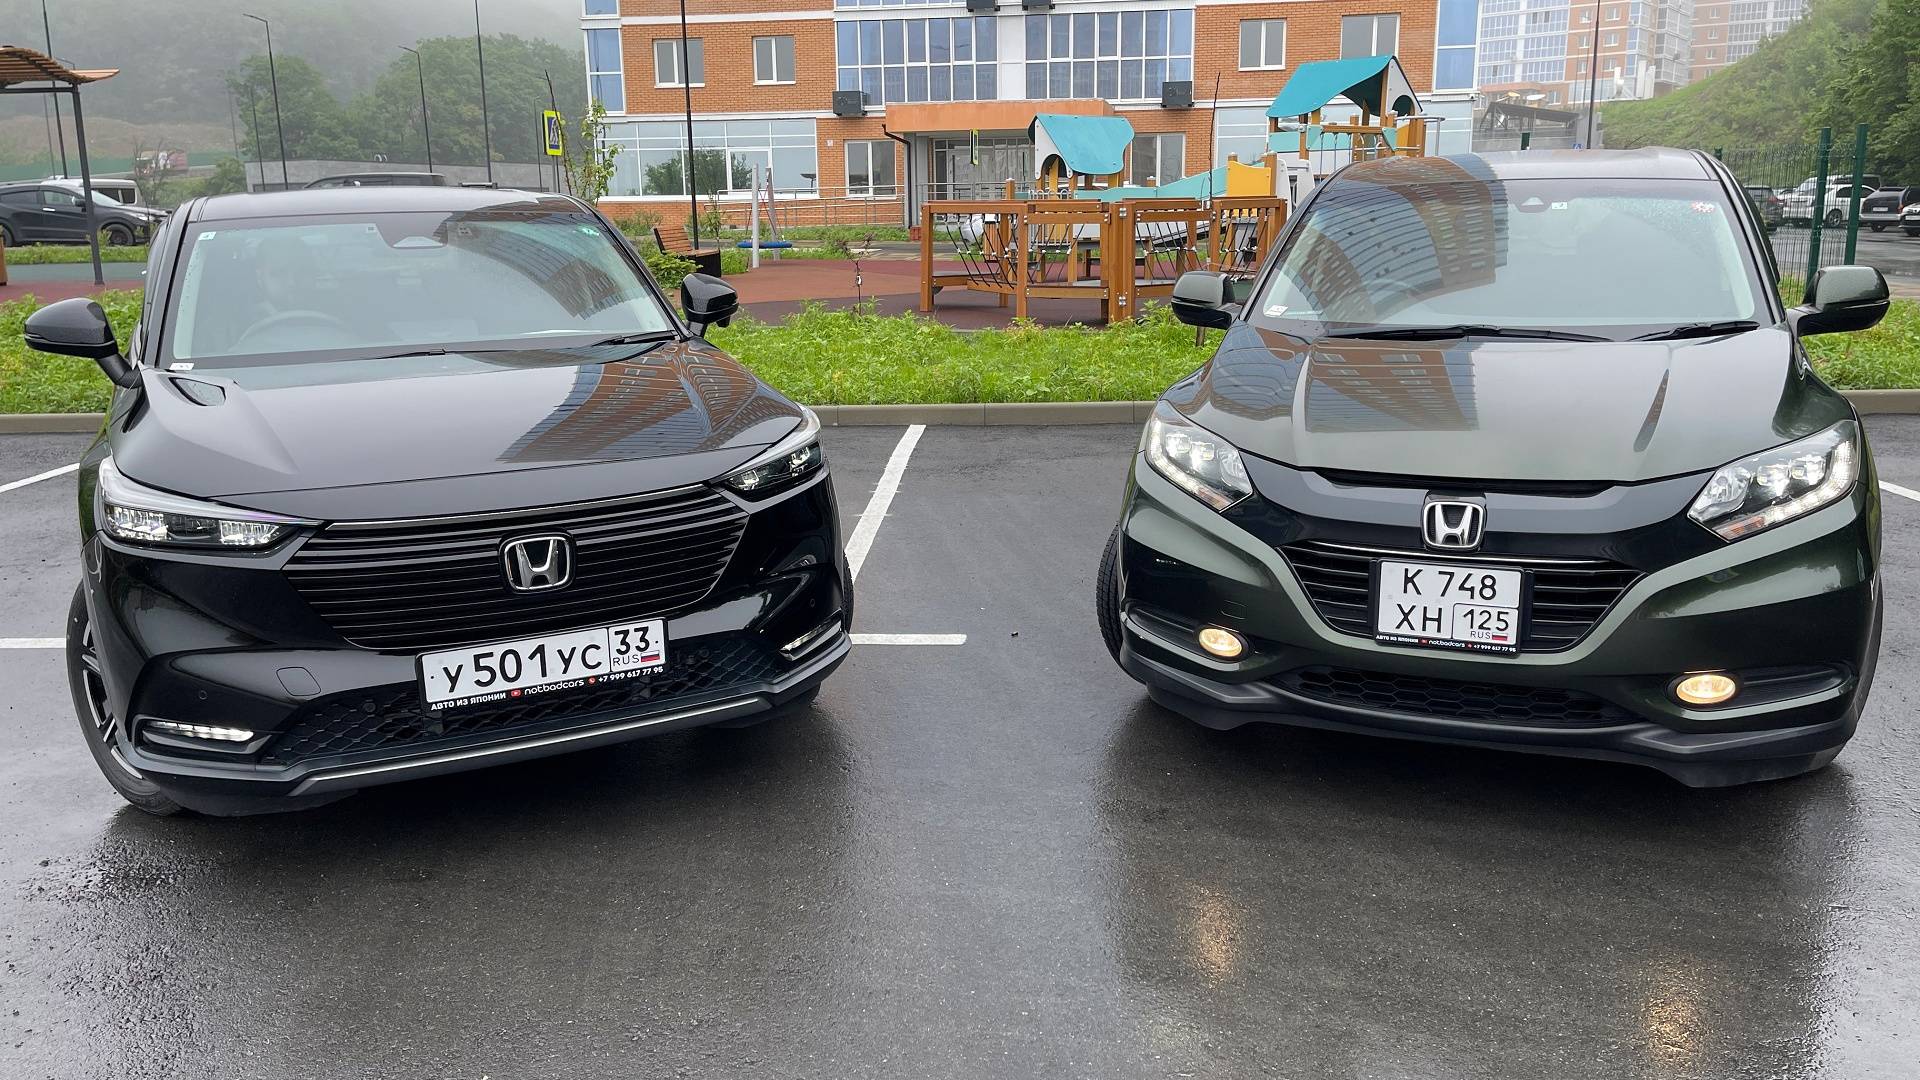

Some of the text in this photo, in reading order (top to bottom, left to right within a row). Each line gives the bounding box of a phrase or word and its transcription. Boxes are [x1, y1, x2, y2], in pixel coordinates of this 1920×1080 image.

[1438, 570, 1497, 601] 748
[1463, 608, 1509, 632] 125
[614, 626, 650, 655] 33
[1470, 630, 1491, 640] RUS
[612, 654, 640, 666] RUS
[609, 672, 625, 681] 999
[627, 670, 640, 678] 617
[642, 668, 651, 676] 77
[653, 666, 664, 674] 95
[524, 679, 584, 695] notbadcars
[430, 692, 506, 711] АВТО ИЗ ЯПОНИИ
